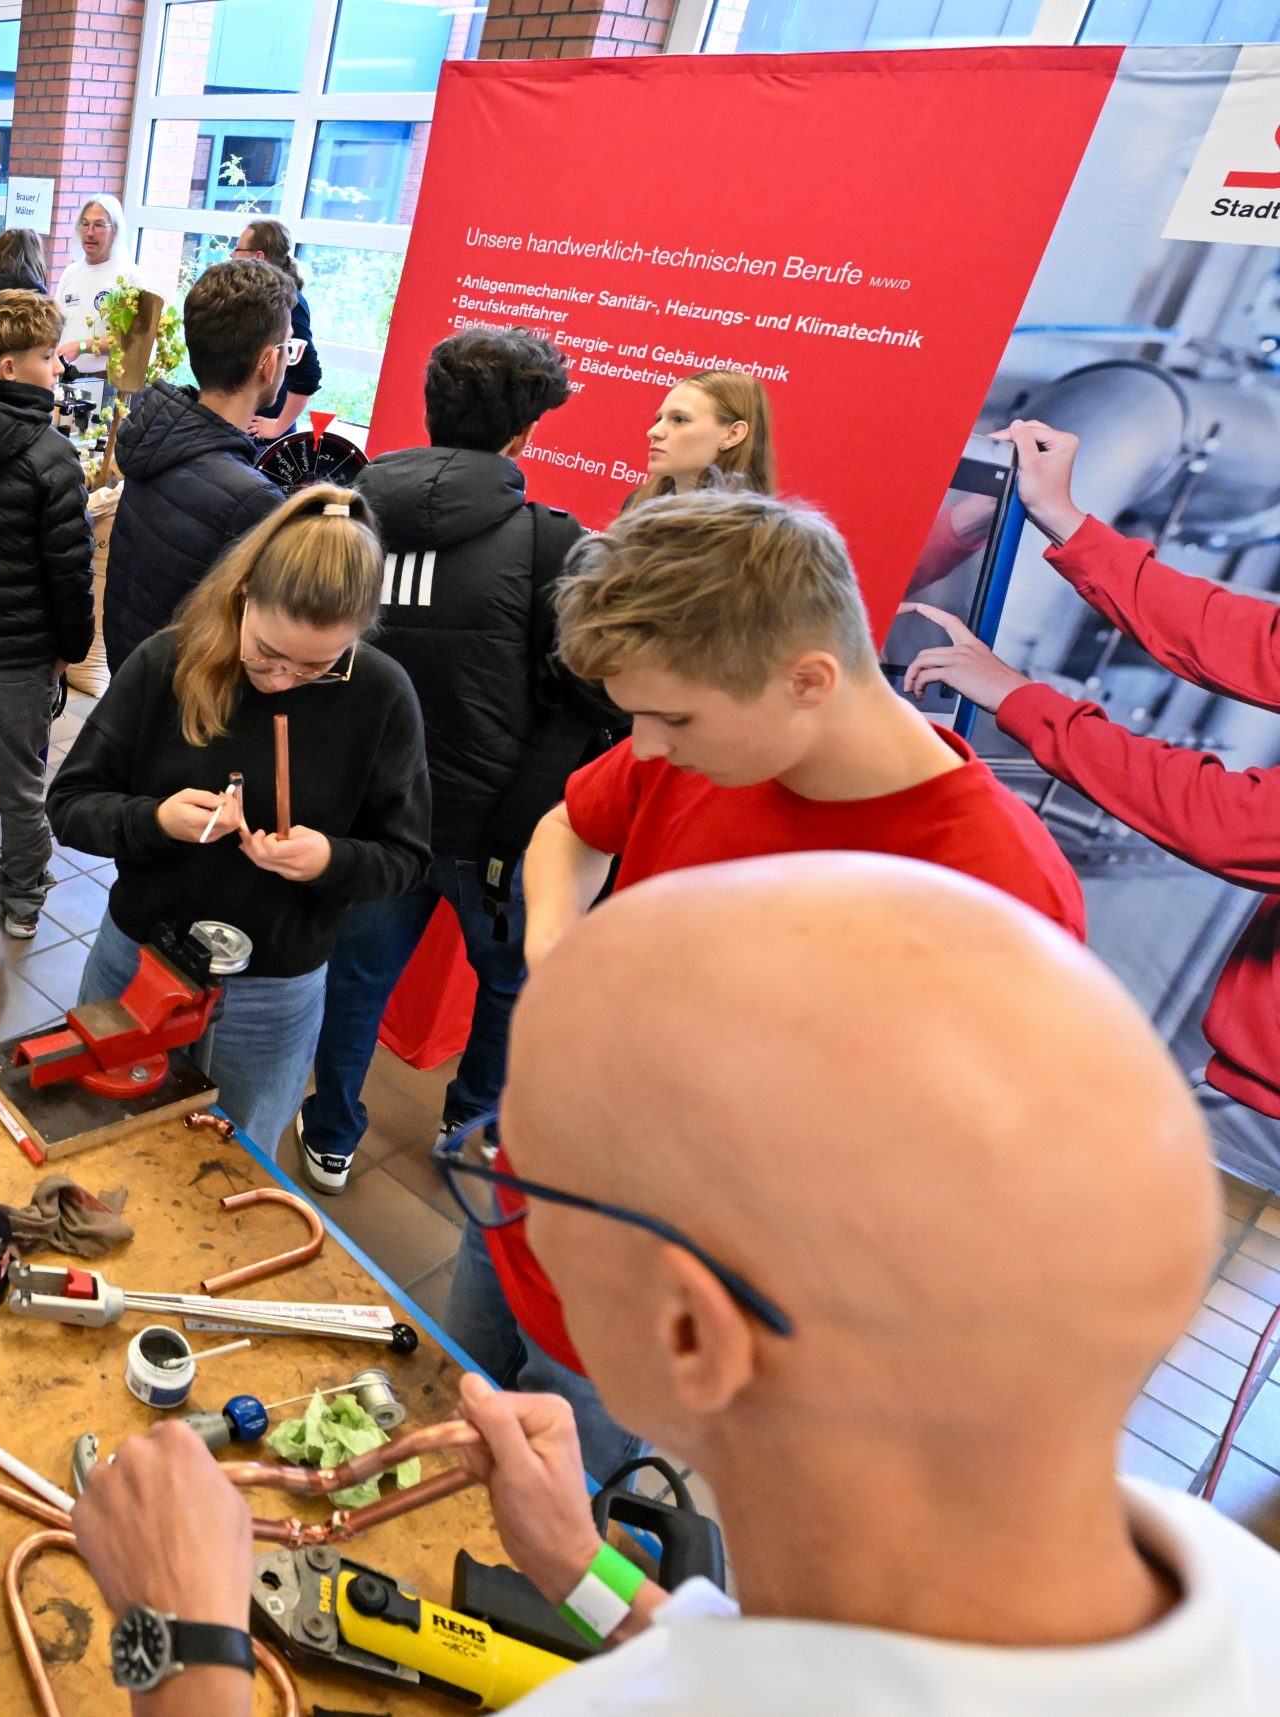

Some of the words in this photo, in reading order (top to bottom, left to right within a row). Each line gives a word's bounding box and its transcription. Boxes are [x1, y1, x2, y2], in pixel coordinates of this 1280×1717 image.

[15, 206, 35, 216] Mälzer
[16, 192, 36, 202] Brauer
[466, 227, 523, 251] Unsere
[526, 232, 777, 277] handwerklich-technischen
[782, 255, 863, 285] Berufe
[869, 276, 911, 290] M/W/D
[458, 295, 569, 323] Berufskraftfahrer
[462, 274, 595, 304] Anlagenmechaniker
[598, 290, 660, 315] Sanitär-,
[665, 299, 751, 326] Heizungs-
[755, 314, 792, 330] und
[795, 315, 924, 348] Klimatechnik
[554, 330, 615, 353] Energie-
[617, 342, 649, 359] und
[651, 346, 791, 382] Gebäudetechnik
[560, 354, 577, 370] ür
[522, 441, 608, 477] ännischen
[326, 1160, 343, 1168] NIKE
[319, 1575, 332, 1614] REMS
[432, 1614, 487, 1644] REMS
